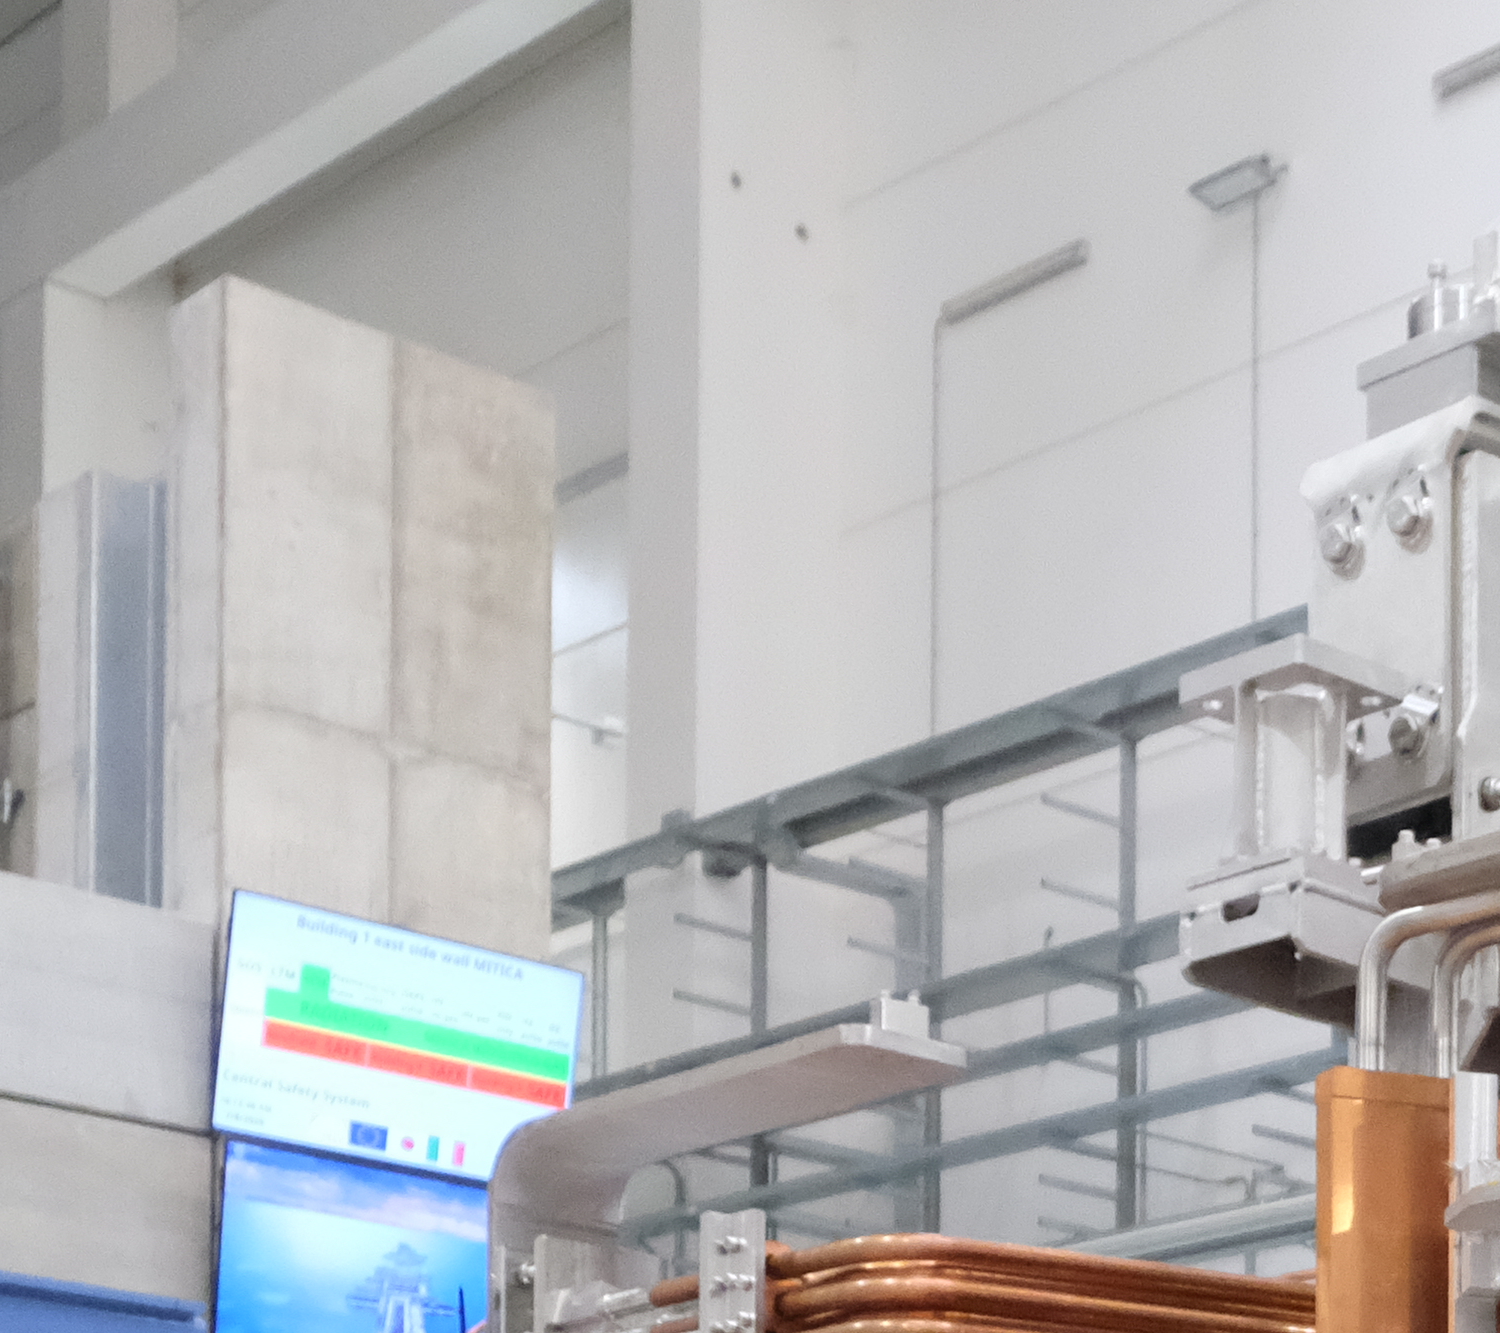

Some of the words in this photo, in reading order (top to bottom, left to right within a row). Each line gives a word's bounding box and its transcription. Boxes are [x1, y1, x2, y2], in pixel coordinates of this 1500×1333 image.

[296, 914, 358, 945] Building
[374, 936, 405, 953] east
[408, 941, 438, 961] side
[441, 949, 471, 968] wall
[473, 956, 525, 981] MITICA
[223, 1067, 273, 1090] Central
[278, 1079, 319, 1101] Safety
[323, 1090, 371, 1110] System
